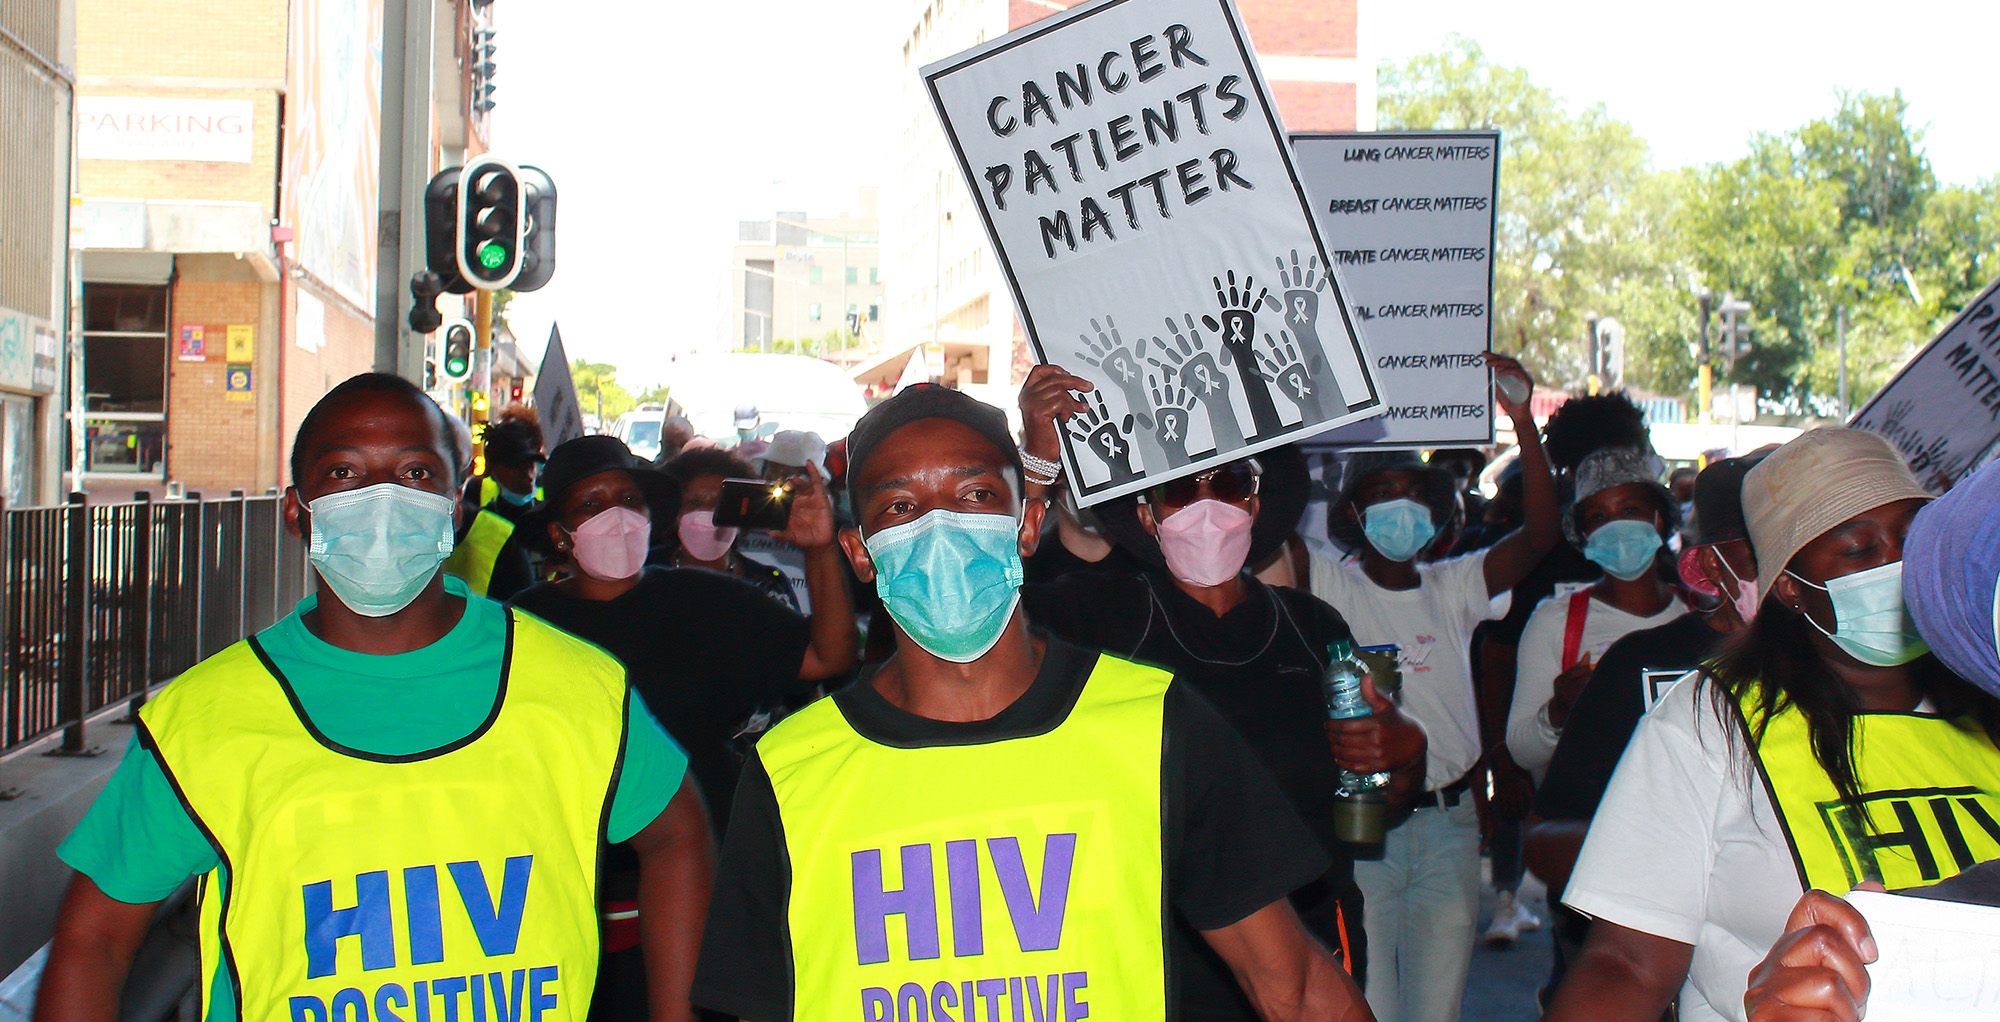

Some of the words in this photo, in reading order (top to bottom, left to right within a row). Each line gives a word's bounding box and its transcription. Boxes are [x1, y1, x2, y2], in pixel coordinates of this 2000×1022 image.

[986, 23, 1210, 139] CANCER
[78, 112, 243, 135] PARKING
[984, 74, 1249, 211] PATIENTS
[1343, 148, 1381, 163] LUNG
[1384, 146, 1434, 161] CANCER
[1435, 146, 1490, 161] MATTERS
[1038, 148, 1255, 259] MATTER
[1329, 199, 1380, 214] BREAST
[1382, 198, 1432, 213] CANCER
[1433, 197, 1488, 212] MATTERS
[1332, 249, 1377, 265] TRATE
[1380, 248, 1430, 263] CANCER
[1431, 247, 1486, 262] MATTERS
[1355, 305, 1376, 321] AL
[1378, 304, 1429, 319] CANCER
[1429, 303, 1484, 318] MATTERS
[1378, 355, 1428, 370] CANCER
[1429, 354, 1483, 369] MATTERS
[1429, 405, 1485, 420] MATTERS
[851, 833, 1077, 966] HIV
[302, 854, 534, 979] HIV
